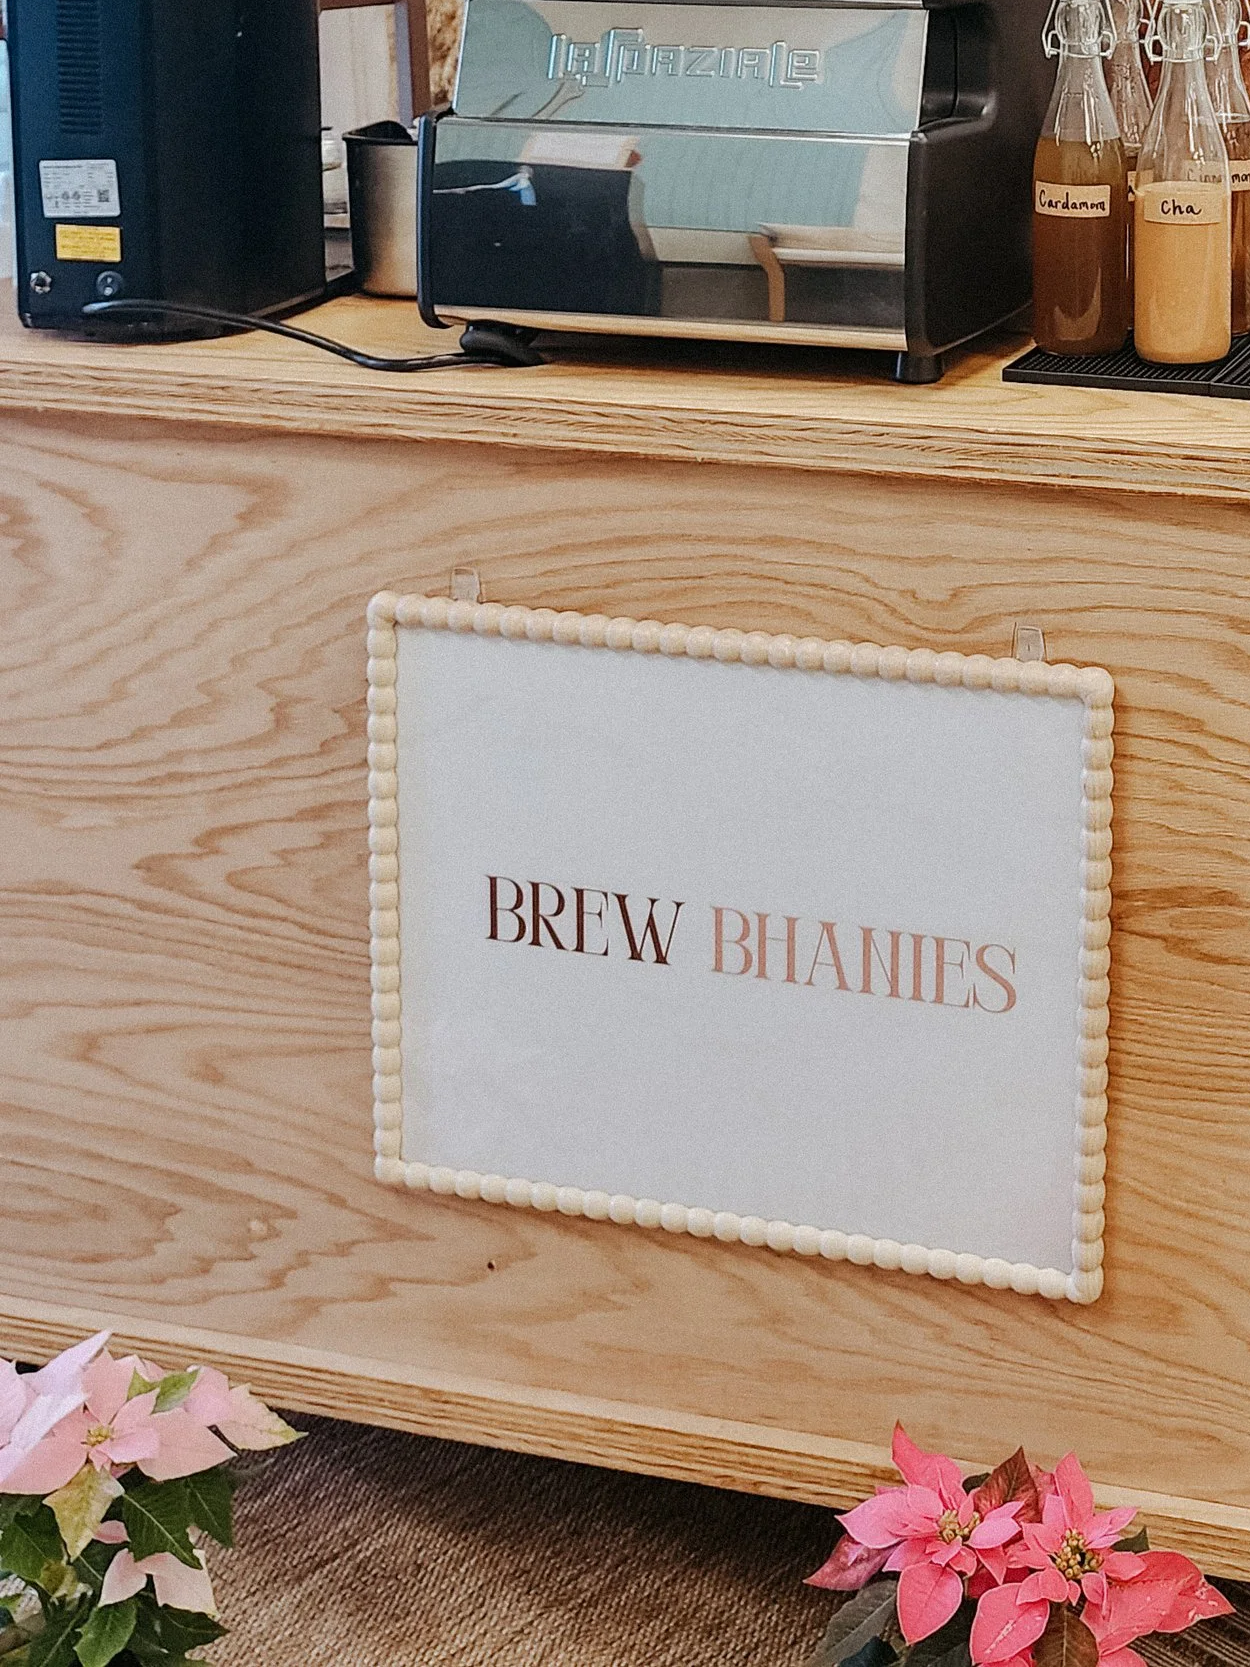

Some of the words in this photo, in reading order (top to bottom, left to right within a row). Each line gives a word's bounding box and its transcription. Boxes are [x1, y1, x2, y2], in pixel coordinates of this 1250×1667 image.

[1160, 198, 1202, 216] Cha
[484, 874, 686, 966] BREW
[710, 905, 1017, 1014] BHANIES
